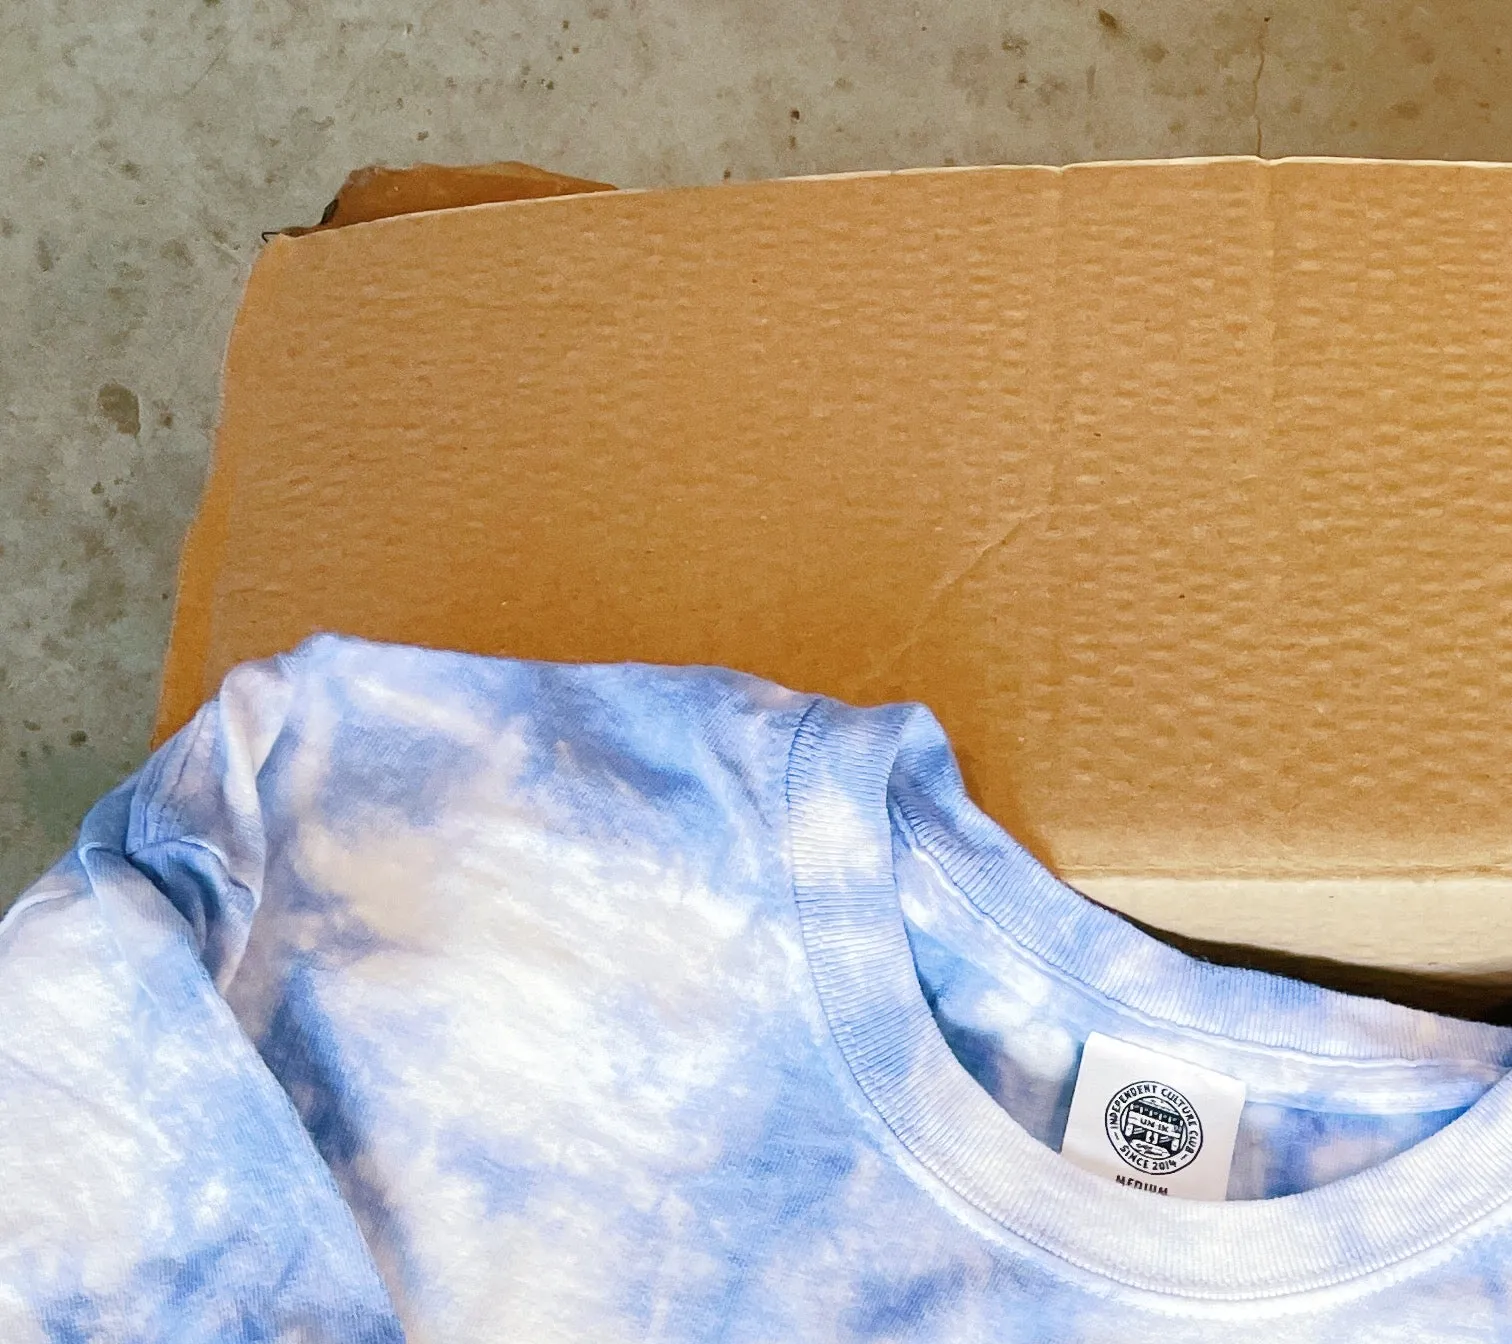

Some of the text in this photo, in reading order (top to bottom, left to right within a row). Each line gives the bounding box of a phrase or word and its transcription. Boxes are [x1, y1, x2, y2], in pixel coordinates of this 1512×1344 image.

[1109, 1084, 1158, 1129] INDEPENDENT
[1161, 1088, 1197, 1127] CULTURE
[1186, 1130, 1199, 1154] CLUB
[1119, 1144, 1150, 1169] SINCE
[1152, 1158, 1177, 1171] 2014
[1115, 1174, 1169, 1196] MEDIUM
